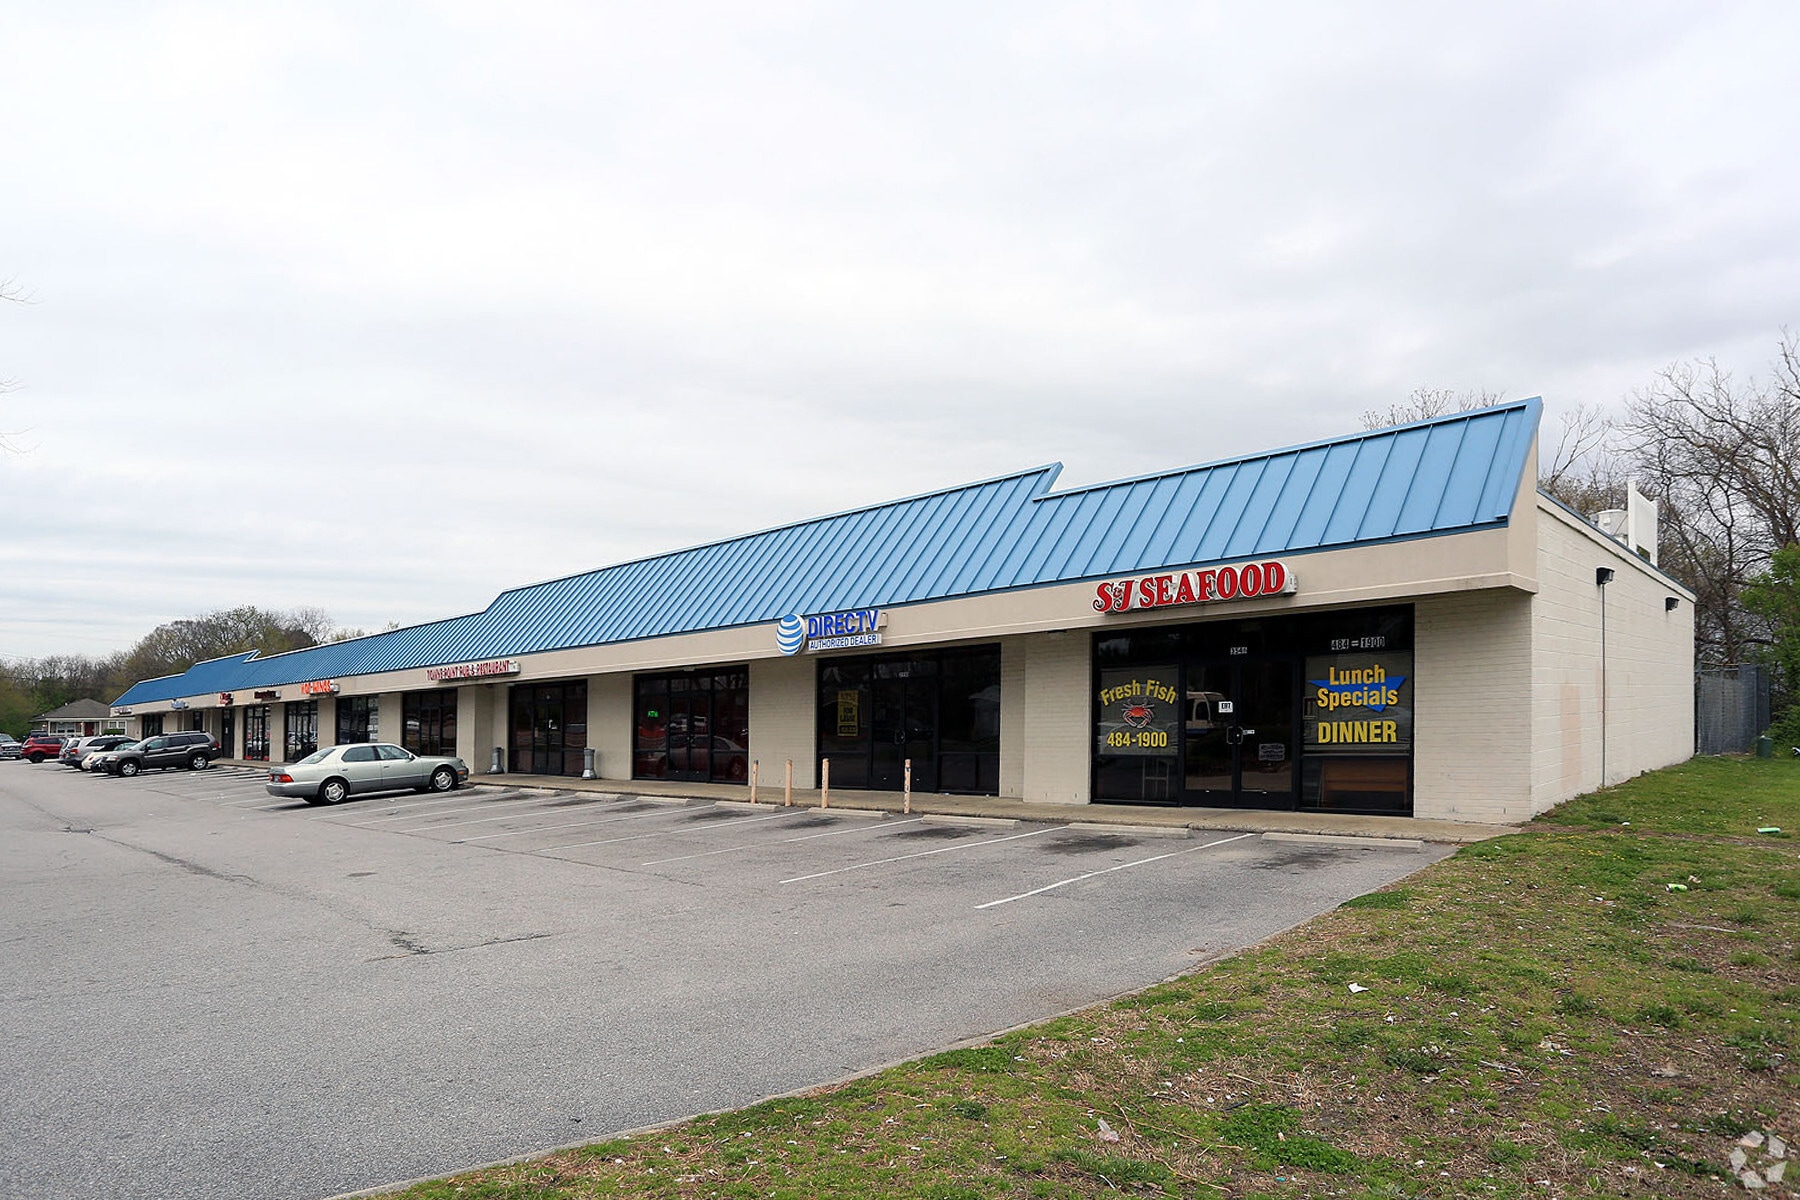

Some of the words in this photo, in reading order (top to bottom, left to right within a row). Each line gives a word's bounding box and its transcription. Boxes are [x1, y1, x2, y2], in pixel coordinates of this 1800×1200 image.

[1093, 580, 1135, 613] S&J
[1139, 562, 1286, 607] SEAFOOD
[808, 609, 879, 638] DIRECTV
[810, 637, 849, 649] AUTHORIZED
[850, 634, 877, 645] DEALER
[1329, 664, 1385, 685] Lunch
[1100, 680, 1141, 706] Fresh
[1145, 680, 1176, 705] Fish
[1317, 686, 1399, 711] Specials
[1107, 732, 1167, 747] 484-1900
[1318, 721, 1397, 743] DINNER
